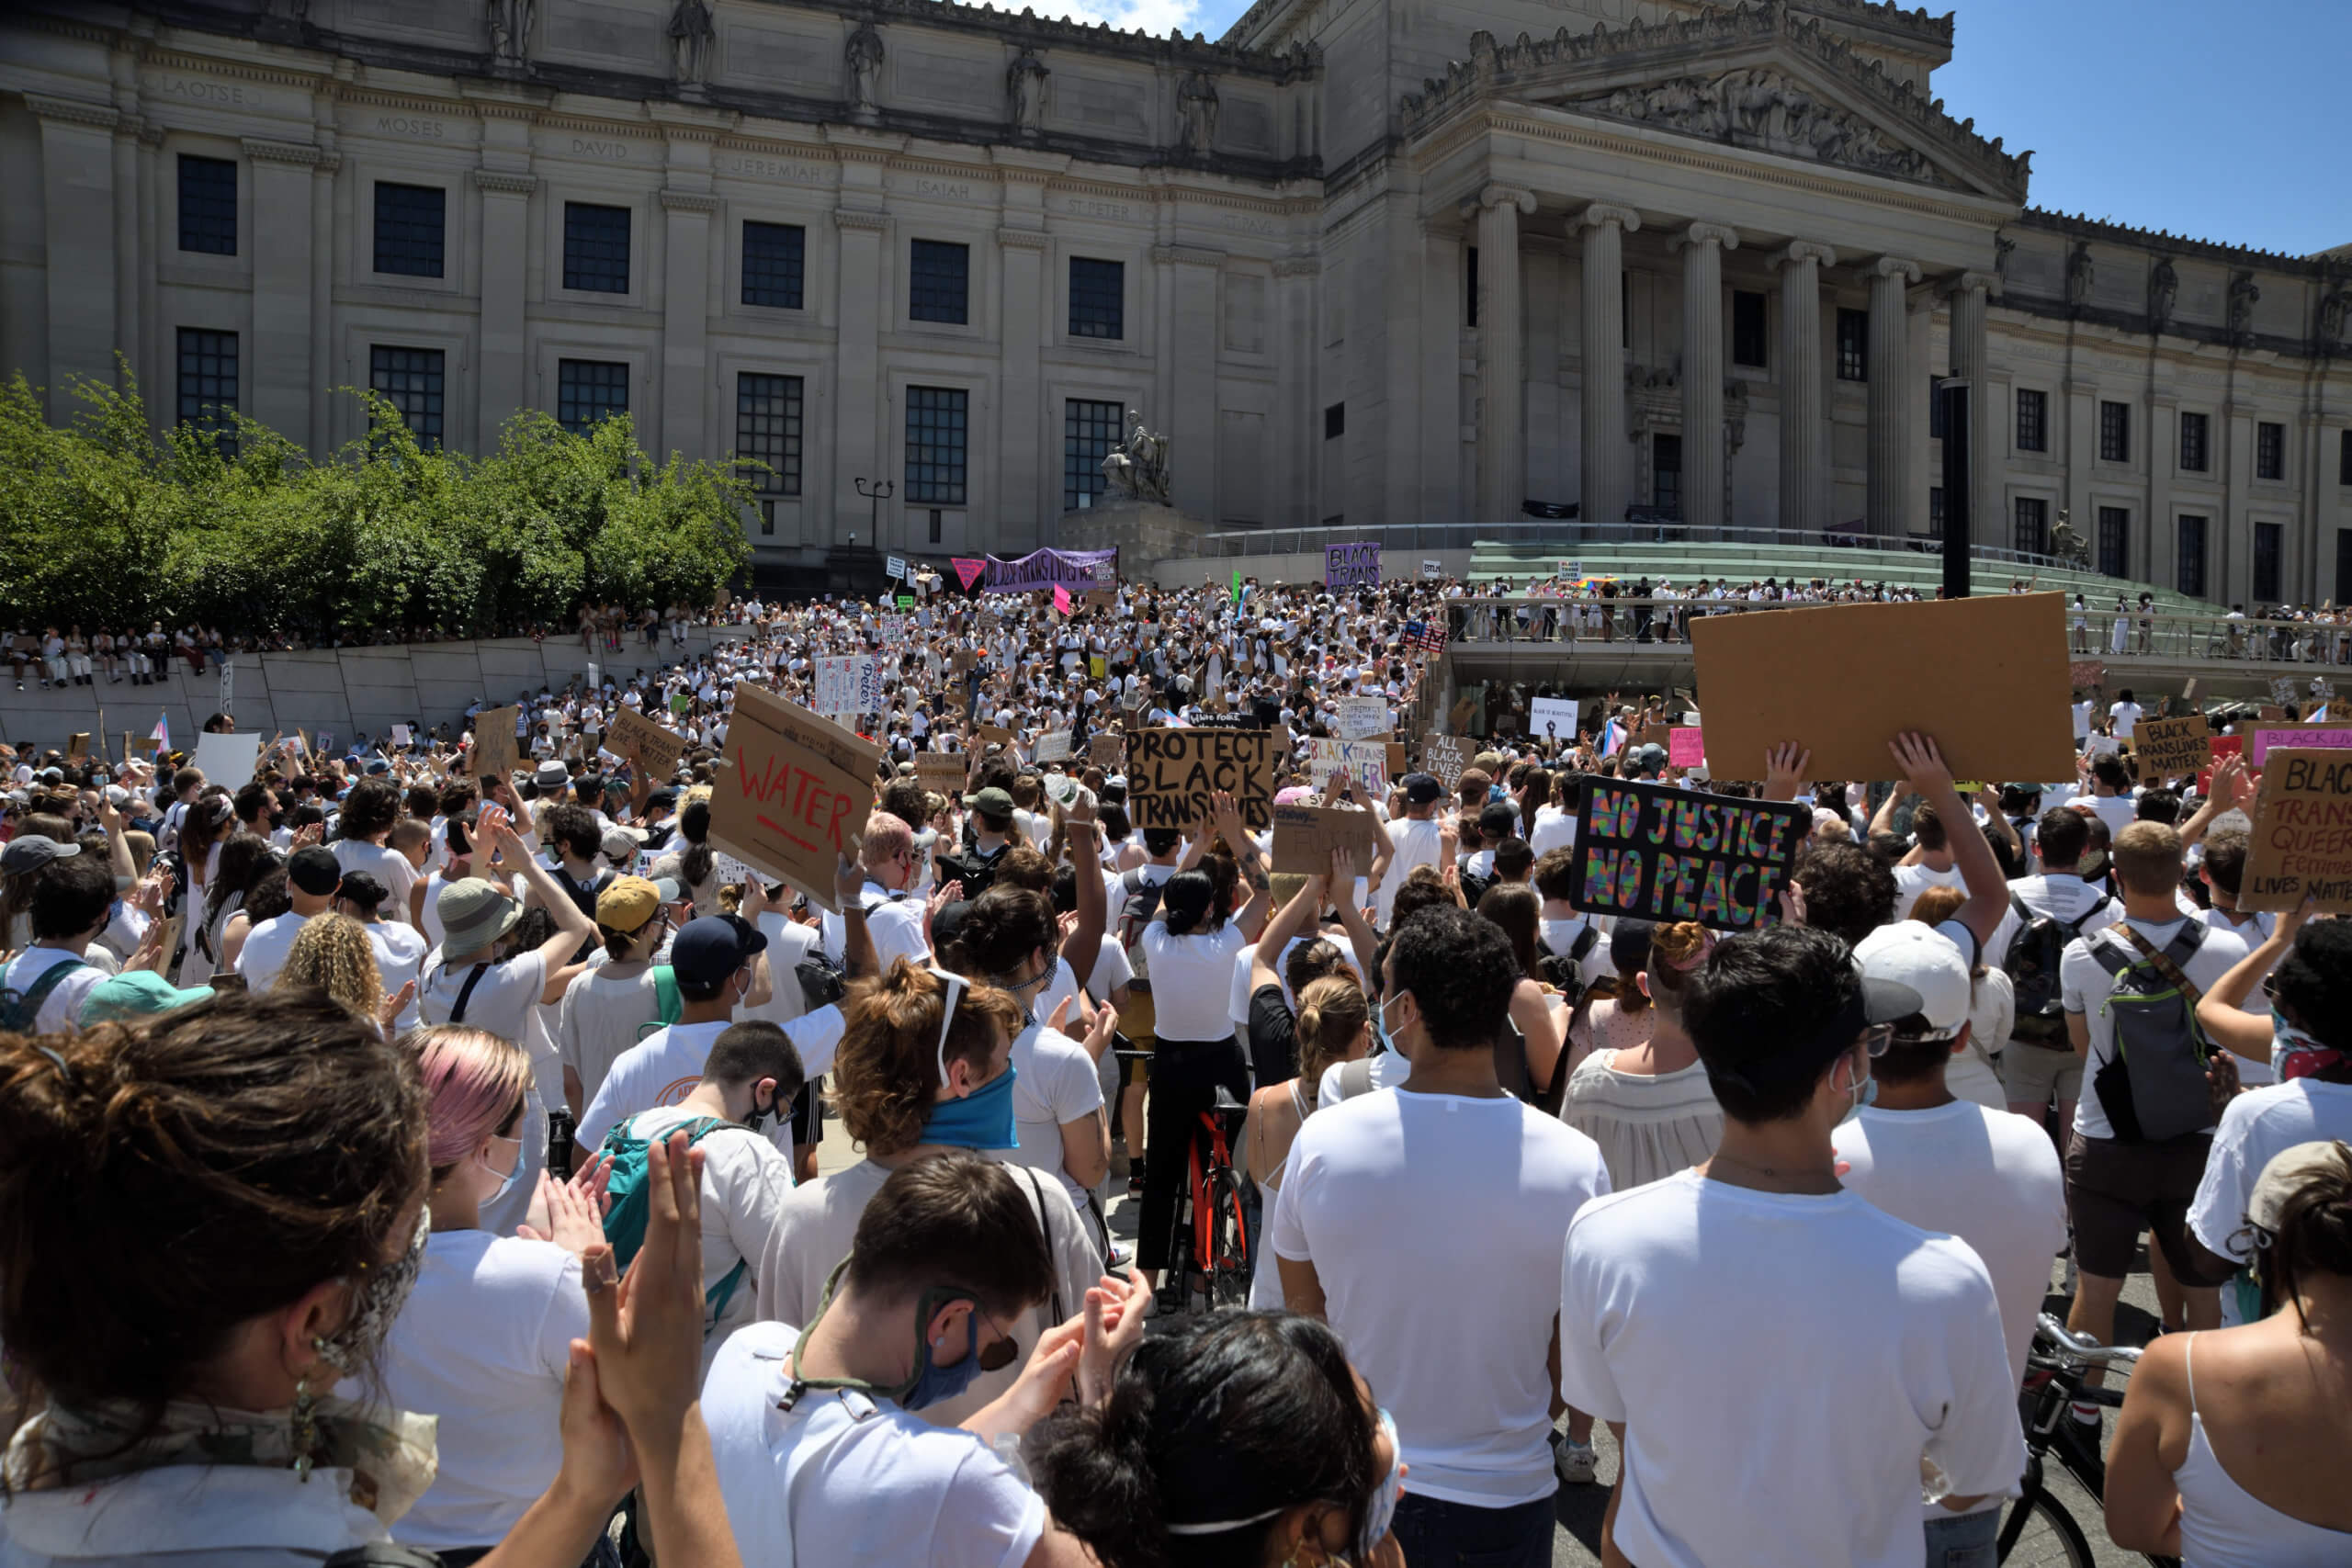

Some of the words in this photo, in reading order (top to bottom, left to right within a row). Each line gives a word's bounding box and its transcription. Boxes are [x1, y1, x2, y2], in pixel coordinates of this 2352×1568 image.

[376, 118, 443, 137] MOSES
[572, 140, 627, 158] DAVID
[732, 160, 820, 182] JEREMIAH
[917, 179, 968, 198] ISAIAH
[1330, 546, 1378, 568] BLACK
[987, 558, 1018, 587] BLACK
[1019, 554, 1049, 583] TRANS
[1050, 552, 1077, 581] LIVES
[1330, 565, 1376, 583] TRANS
[860, 663, 873, 708] Peter
[610, 730, 631, 746] LIVE
[617, 718, 648, 739] BLACK
[650, 735, 678, 757] TRANS
[2146, 722, 2191, 742] BLACK
[2267, 732, 2327, 745] BLACK
[1126, 731, 1272, 762] PROTECT
[1311, 739, 1353, 762] BLACK
[1351, 746, 1385, 761] TRANS
[1437, 736, 1458, 750] ALL
[2137, 741, 2177, 757] TRANS
[1427, 748, 1464, 763] BLACK
[2151, 754, 2202, 773] MATTER
[1129, 761, 1269, 797] BLACK
[1427, 761, 1461, 777] LIVES
[738, 745, 853, 852] WATER
[1129, 792, 1207, 826] TRANS
[1589, 787, 1640, 839] NO
[1647, 797, 1791, 862] JUSTICE
[1584, 847, 1642, 909] NO
[1651, 852, 1781, 929] PEACE
[2254, 876, 2300, 895] LIVES
